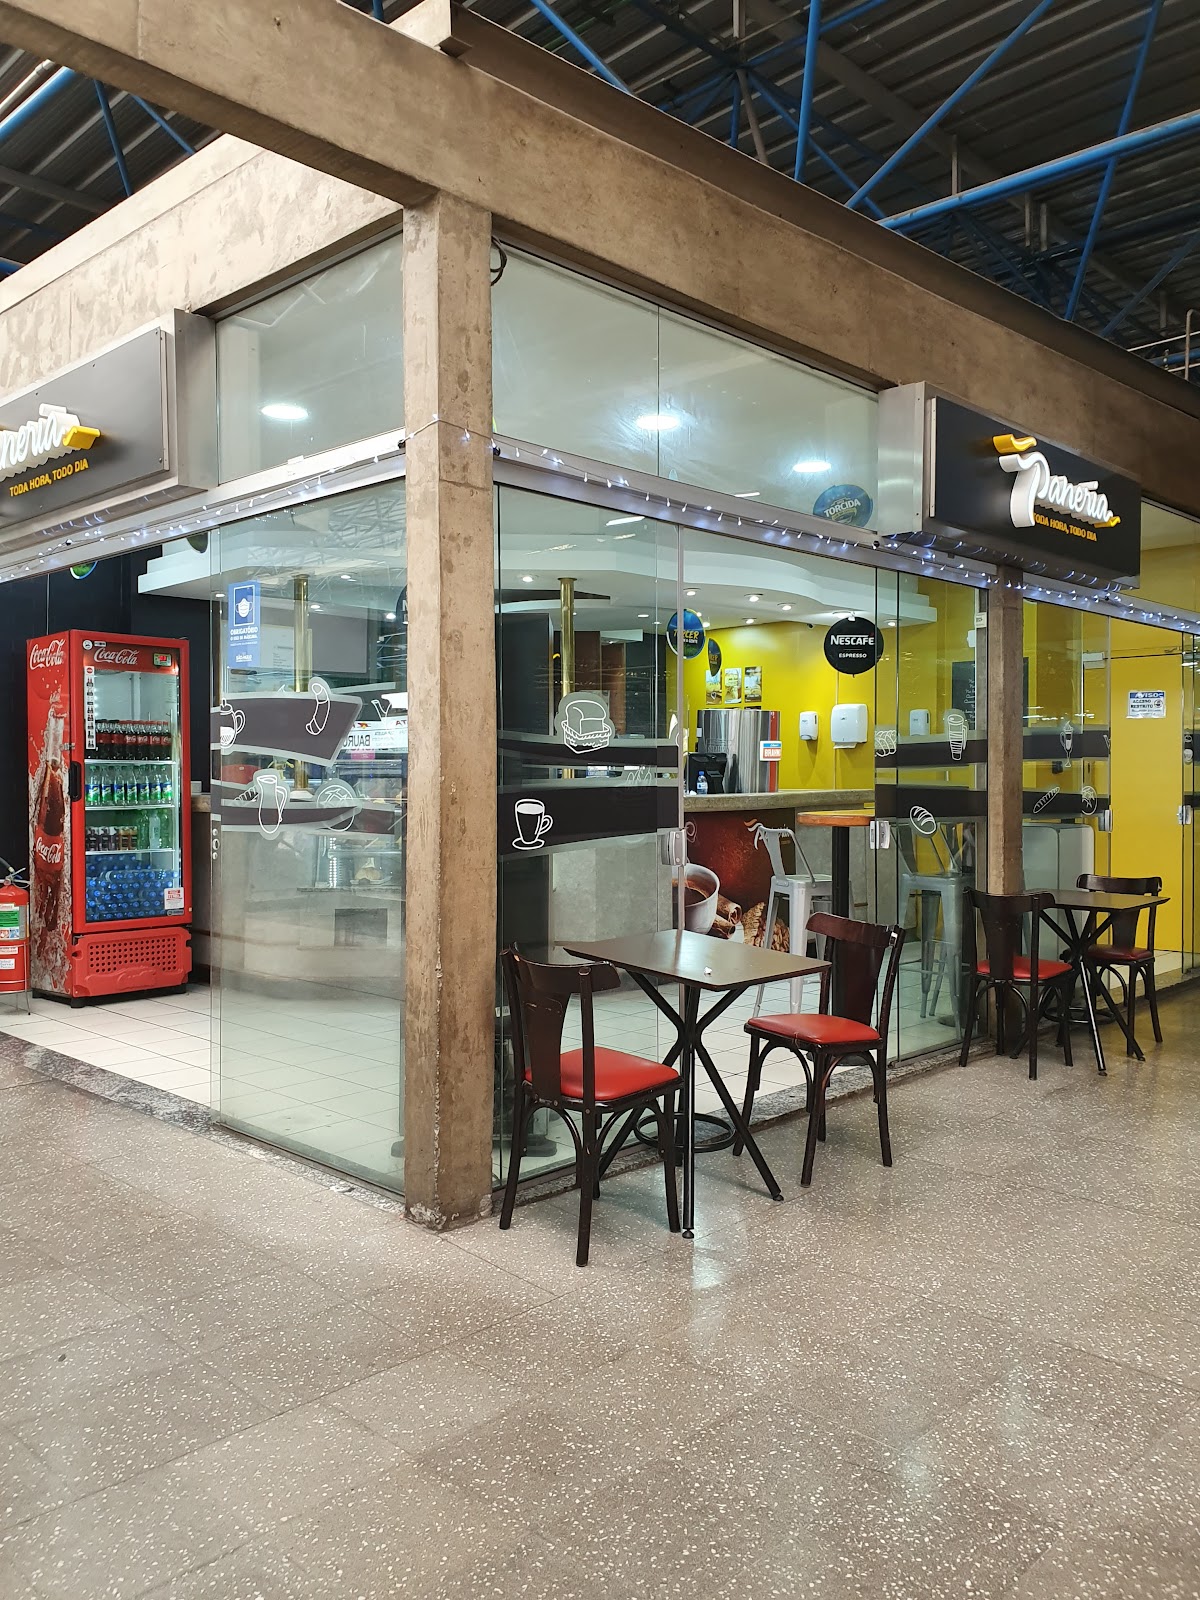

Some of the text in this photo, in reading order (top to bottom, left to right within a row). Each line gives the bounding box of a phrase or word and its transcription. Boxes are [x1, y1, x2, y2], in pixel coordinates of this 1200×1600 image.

[9, 458, 89, 497] TODA HORA, TODO DIA
[824, 498, 861, 518] TORCIDA
[1050, 519, 1069, 534] HORA,
[1069, 525, 1086, 538] TODO
[1087, 531, 1097, 541] DIA
[30, 639, 65, 670] Coca-Cola
[93, 647, 139, 665] Coca-Cola
[36, 836, 62, 864] Coca-Cola
